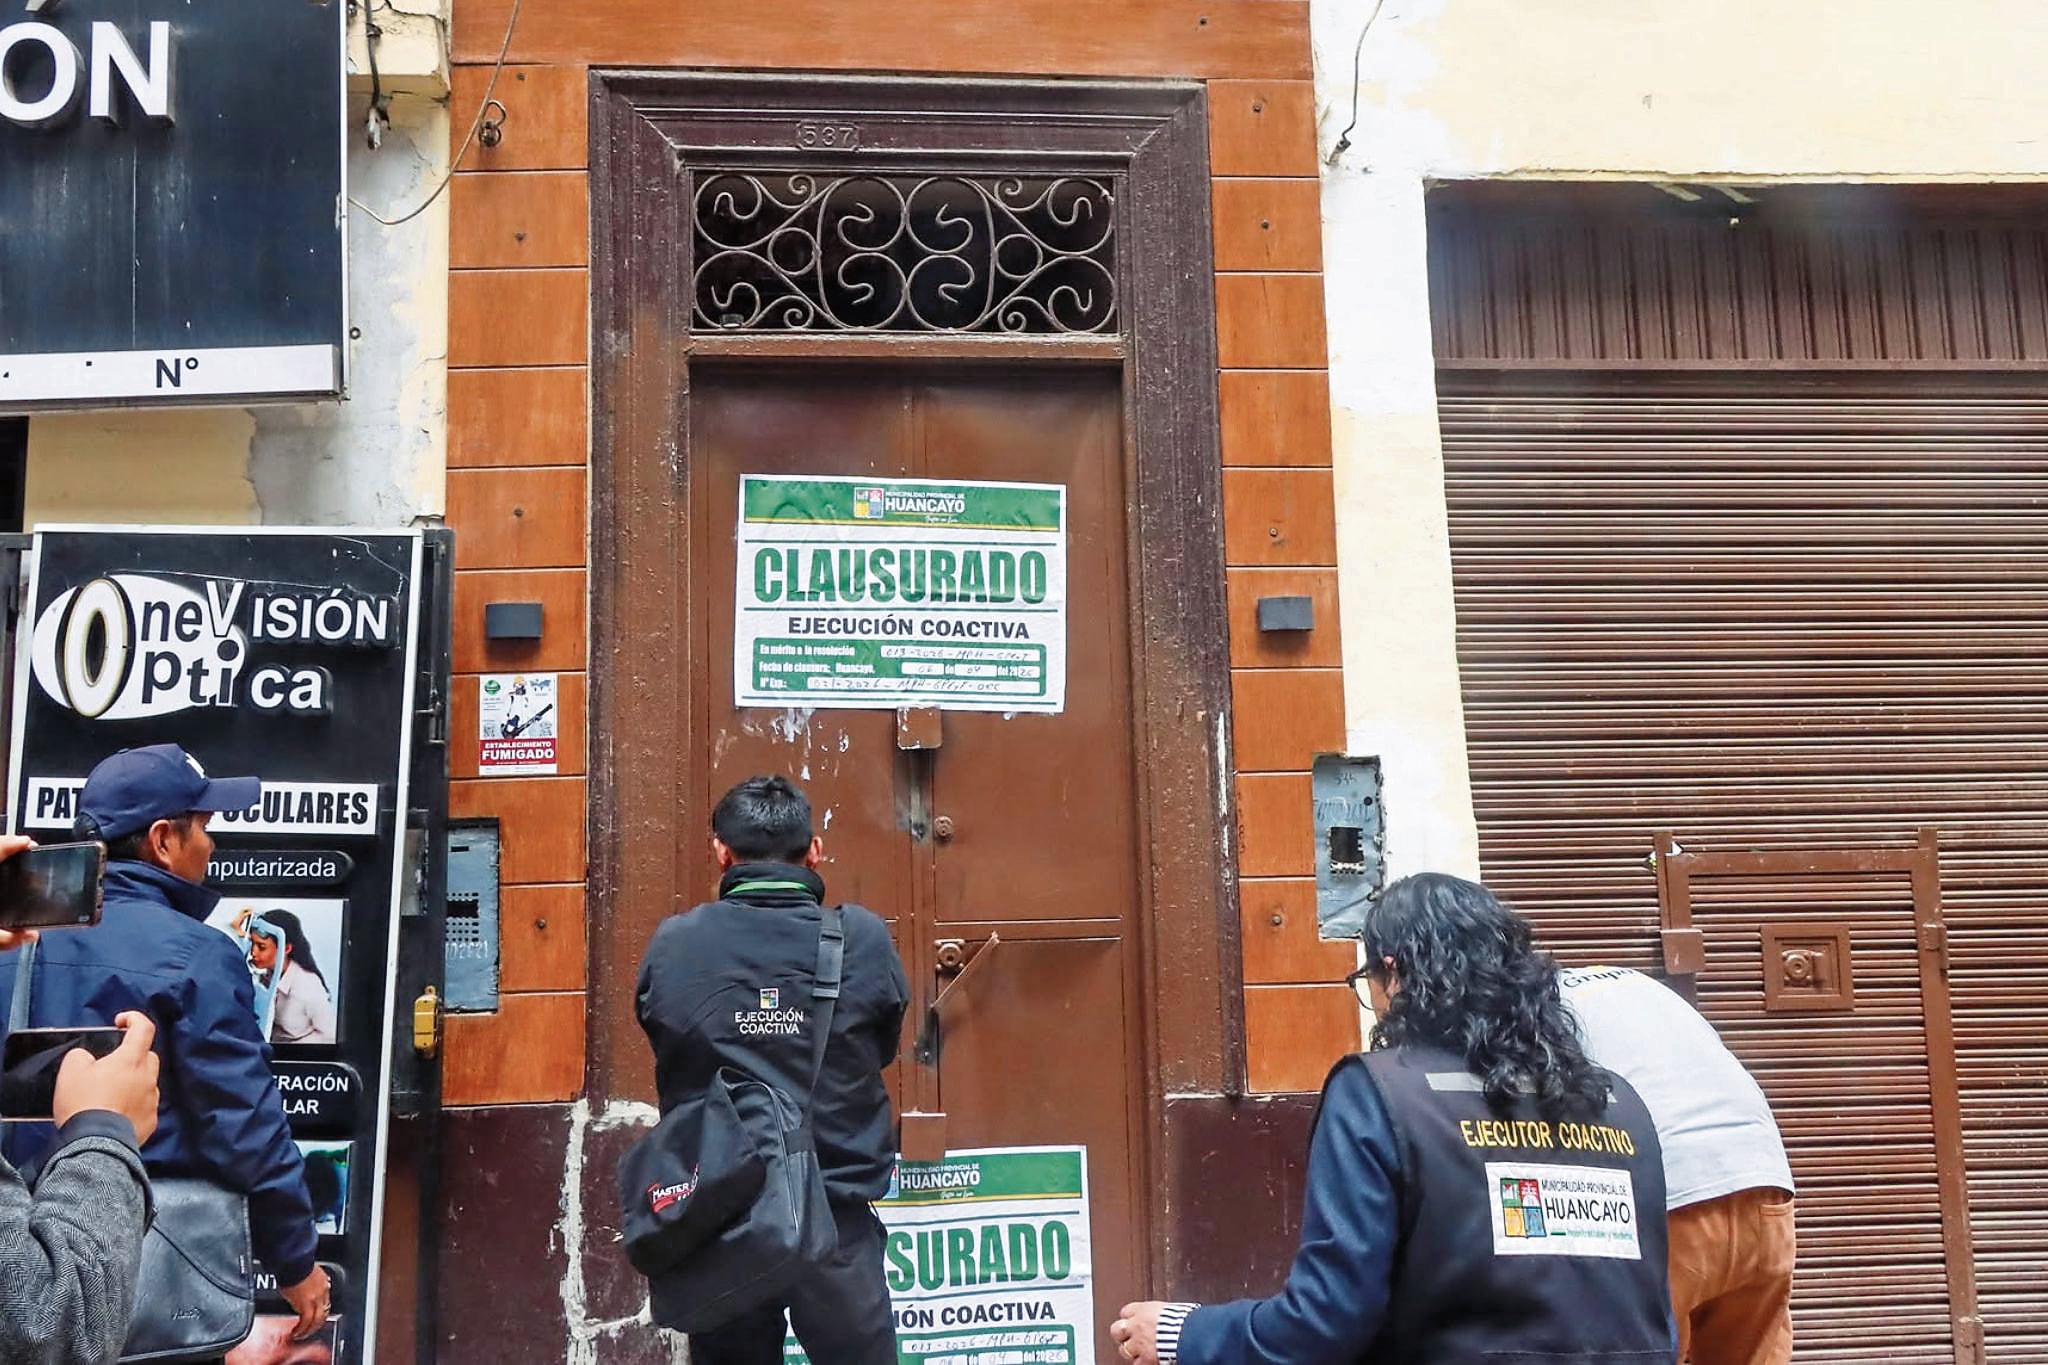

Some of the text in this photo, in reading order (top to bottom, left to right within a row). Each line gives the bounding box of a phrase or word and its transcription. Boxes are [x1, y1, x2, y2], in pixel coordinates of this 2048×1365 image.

[803, 126, 854, 146] 537
[885, 498, 965, 513] HUANCAYO
[754, 547, 1047, 604] CLAUSURADO
[788, 614, 1030, 639] EJECUCIÓN COACTIVA
[759, 661, 782, 672] Fecha
[782, 662, 793, 672] de
[482, 748, 554, 760] FUMIGADO
[485, 741, 552, 749] ESTABLECIMIENTO
[1563, 969, 1634, 988] Grupo
[735, 1007, 803, 1022] EJECUCIÓN
[740, 1023, 800, 1034] COACTIVA
[272, 1073, 349, 1092] RACIÓN
[282, 1099, 319, 1114] LAR
[1460, 1120, 1636, 1156] EJECUTOR COACTIVO
[900, 1171, 980, 1189] HUANCAYO
[1542, 1179, 1586, 1193] MUNICIPALIDAD
[1587, 1182, 1618, 1195] PROVINCIAL
[653, 1183, 689, 1203] MASTER
[1545, 1197, 1631, 1223] HUANCAYO
[941, 1301, 1056, 1328] COACTIVA
